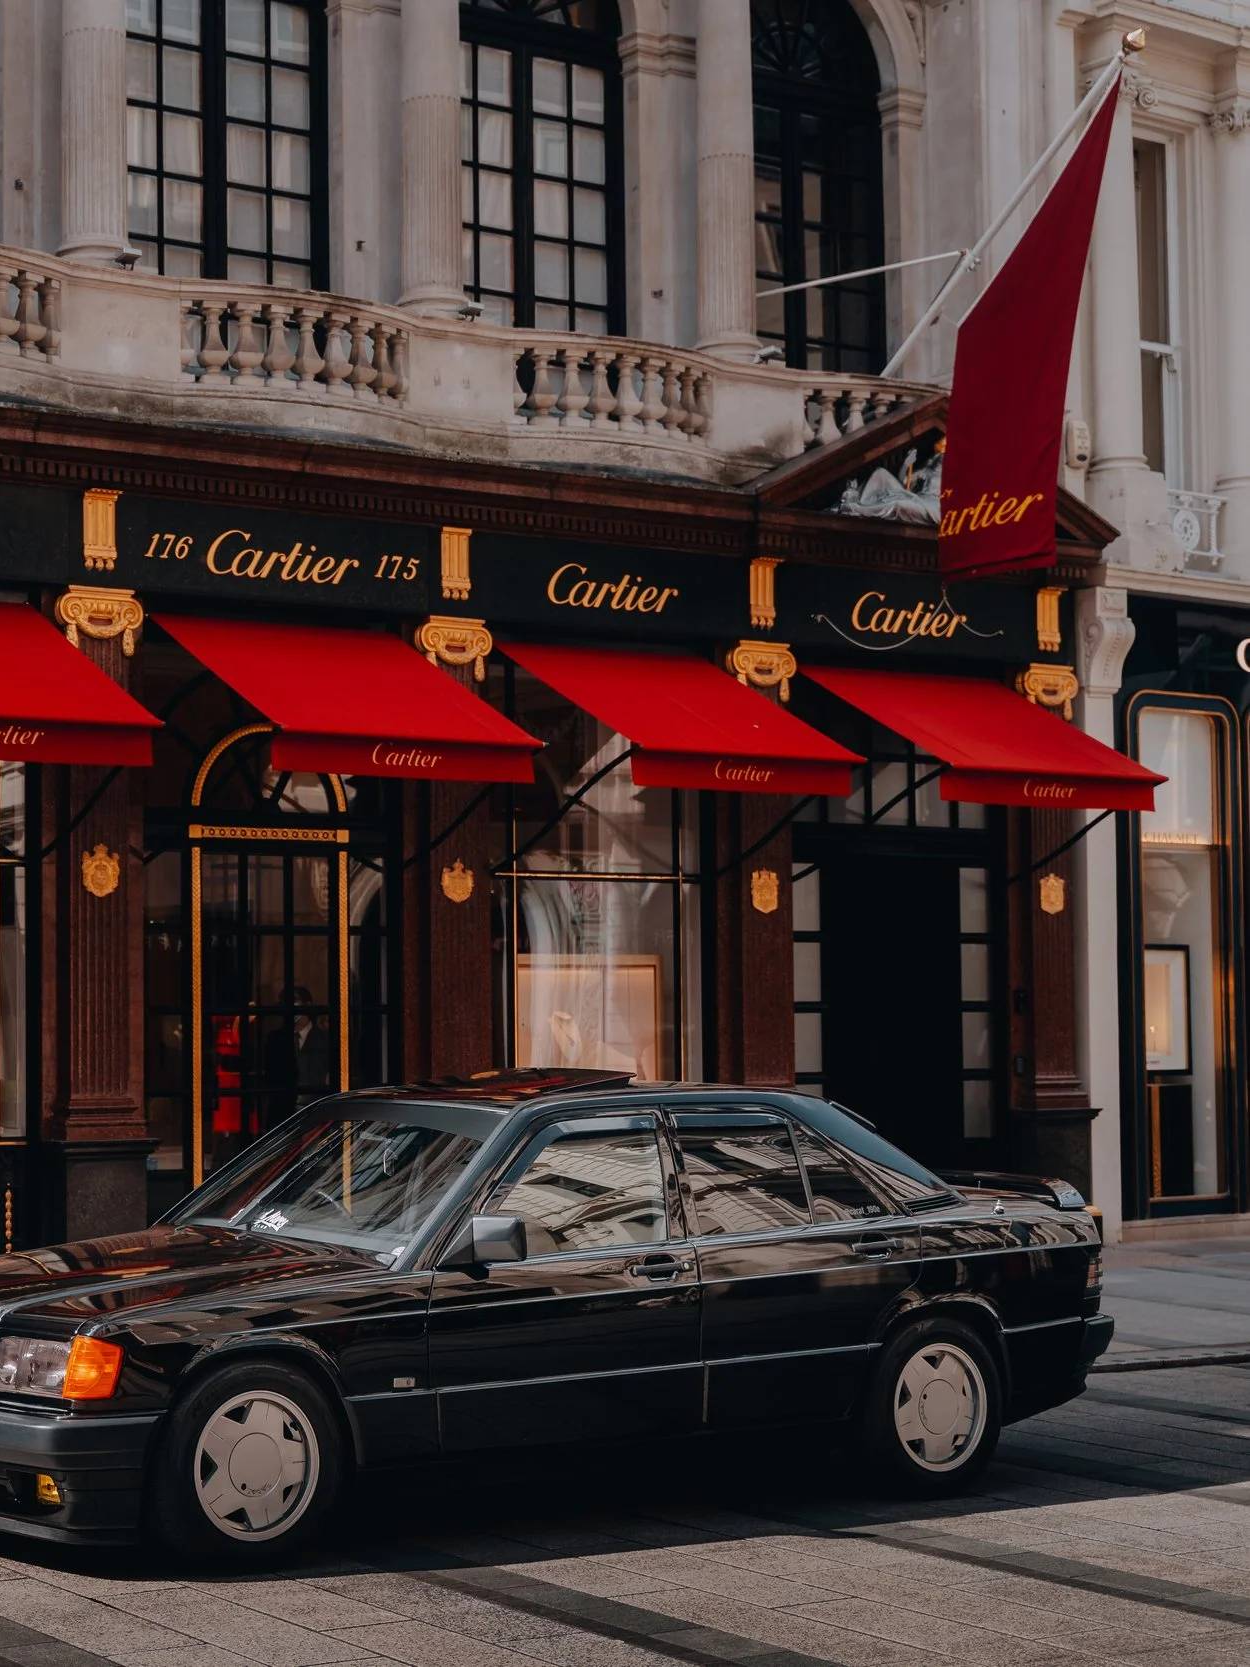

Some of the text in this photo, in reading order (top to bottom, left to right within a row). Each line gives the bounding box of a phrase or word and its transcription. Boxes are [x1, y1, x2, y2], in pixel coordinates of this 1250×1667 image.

[938, 489, 1044, 538] artier
[144, 529, 420, 585] 176 Cartier 175
[547, 563, 679, 613] Cartier
[851, 591, 968, 638] Cartier
[372, 742, 442, 768] Cartier
[715, 760, 774, 782] Cartier
[1023, 779, 1077, 798] Cartier
